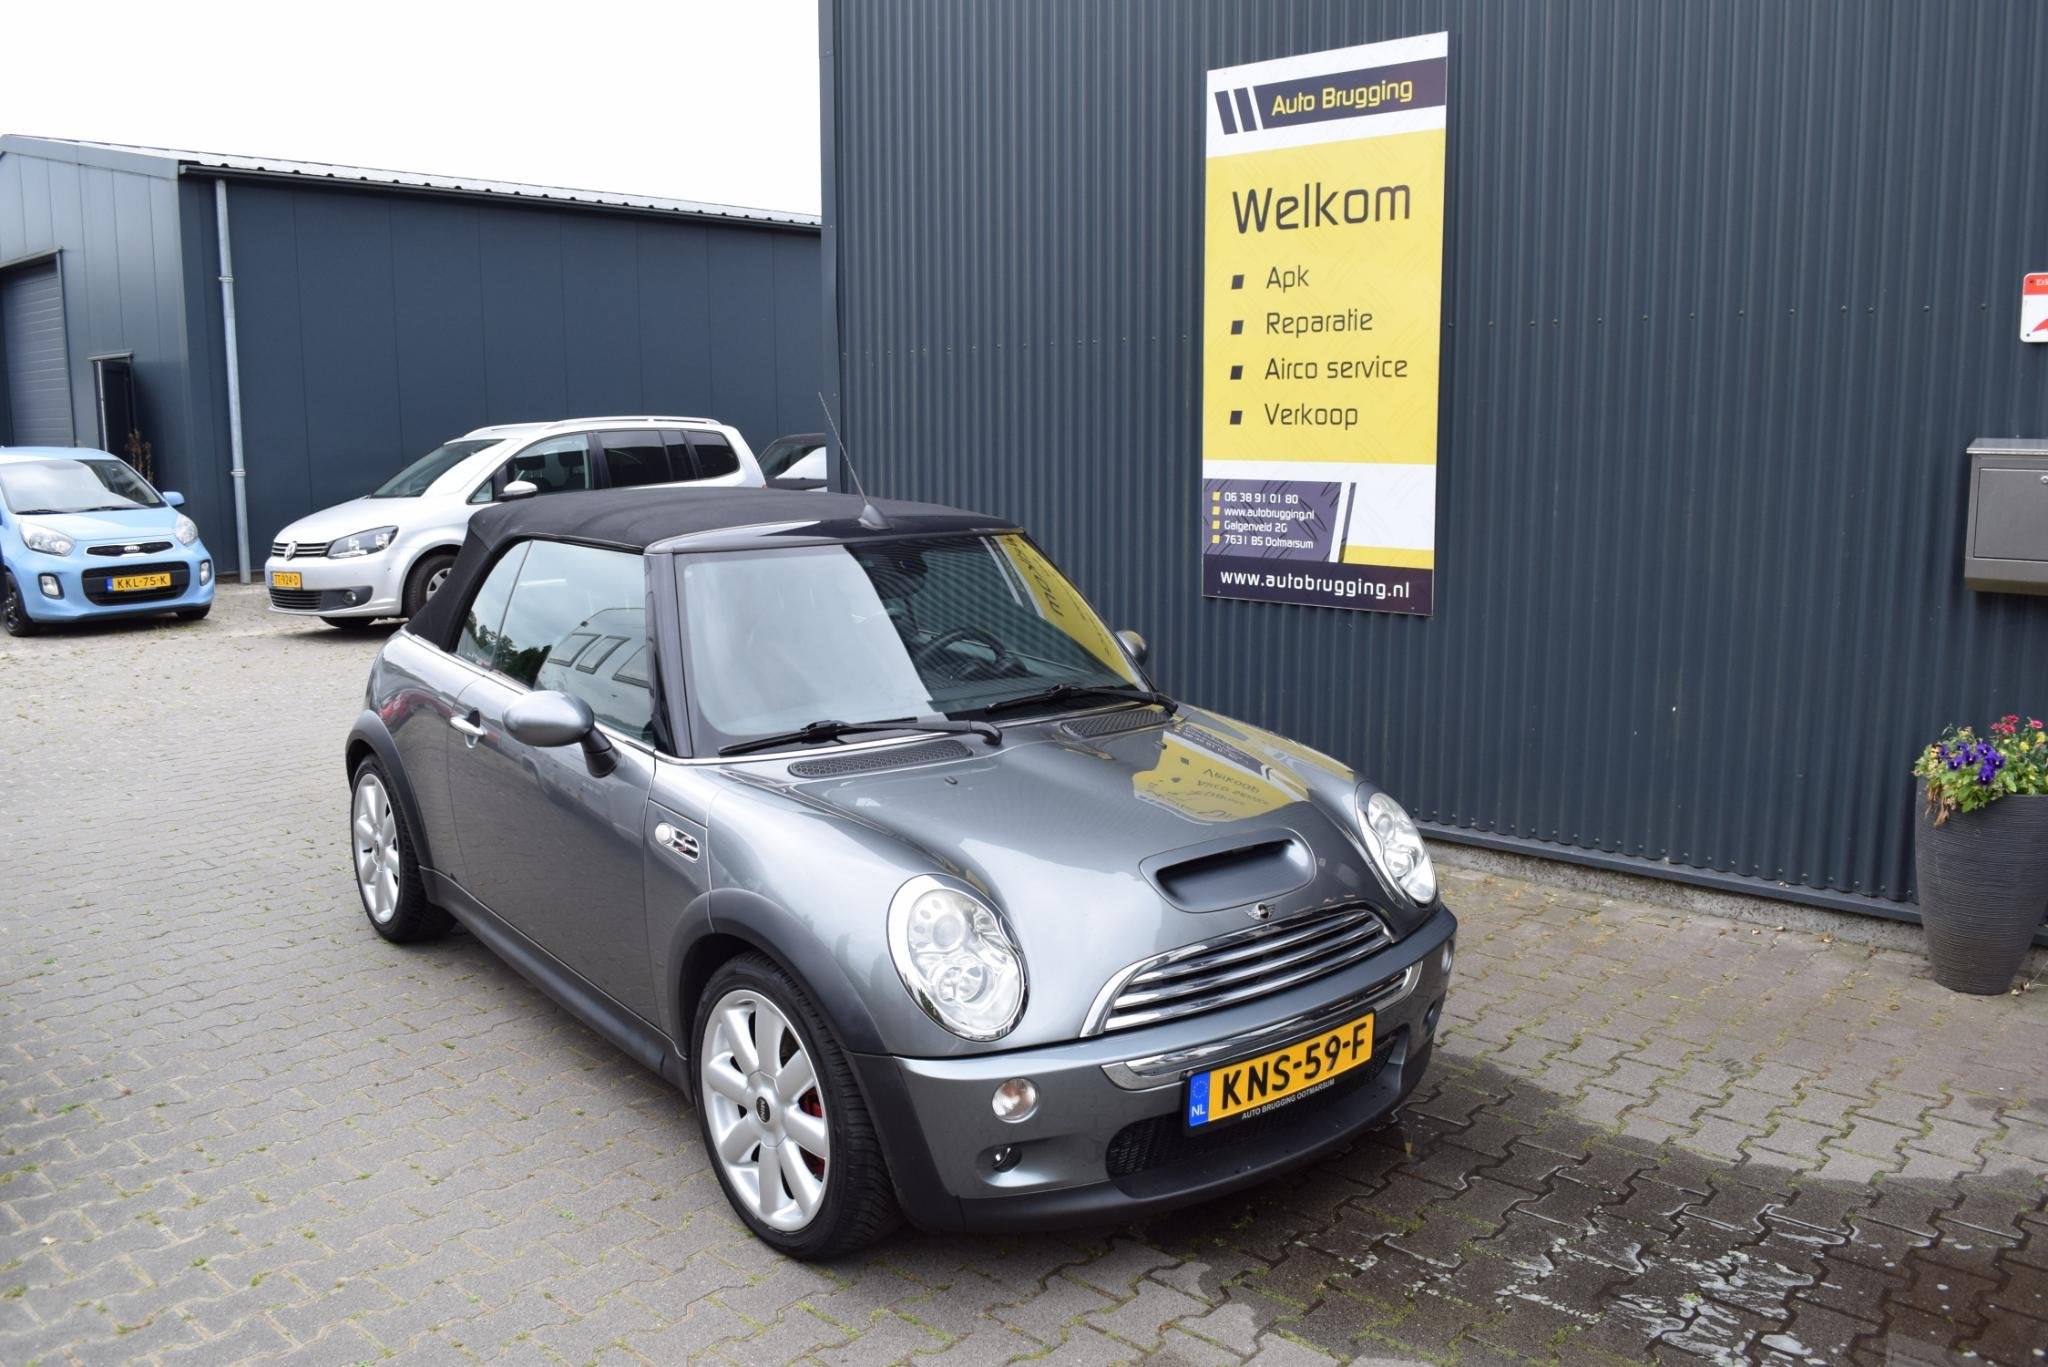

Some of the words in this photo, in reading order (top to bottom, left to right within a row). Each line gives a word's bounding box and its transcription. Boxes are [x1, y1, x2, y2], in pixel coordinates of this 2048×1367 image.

[1271, 91, 1315, 116] Auto
[1321, 79, 1413, 109] Brugging
[1231, 182, 1411, 234] Welkom
[1265, 265, 1310, 293] Apk
[1266, 308, 1373, 339] Reparatie
[1264, 357, 1318, 380] Airco
[1327, 355, 1408, 379] service
[1264, 403, 1359, 431] Verkoop
[1224, 492, 1237, 502] 06
[1239, 492, 1252, 503] 38
[1254, 493, 1266, 503] 91
[1269, 493, 1281, 504] 01
[1285, 494, 1299, 504] 80
[1224, 508, 1315, 522] www.autobrugging.nl
[1224, 520, 1272, 533] Galgenveld
[1224, 534, 1247, 545] 7631
[1265, 536, 1314, 549] Ootmarsum
[116, 575, 168, 589] KKL-75-K
[1220, 570, 1410, 600] www.autobrugging.nl
[1221, 1022, 1367, 1110] KNS-59-F
[1191, 1104, 1206, 1117] NL
[1241, 1107, 1261, 1120] AUTO
[1261, 1094, 1297, 1113] BRUGGING
